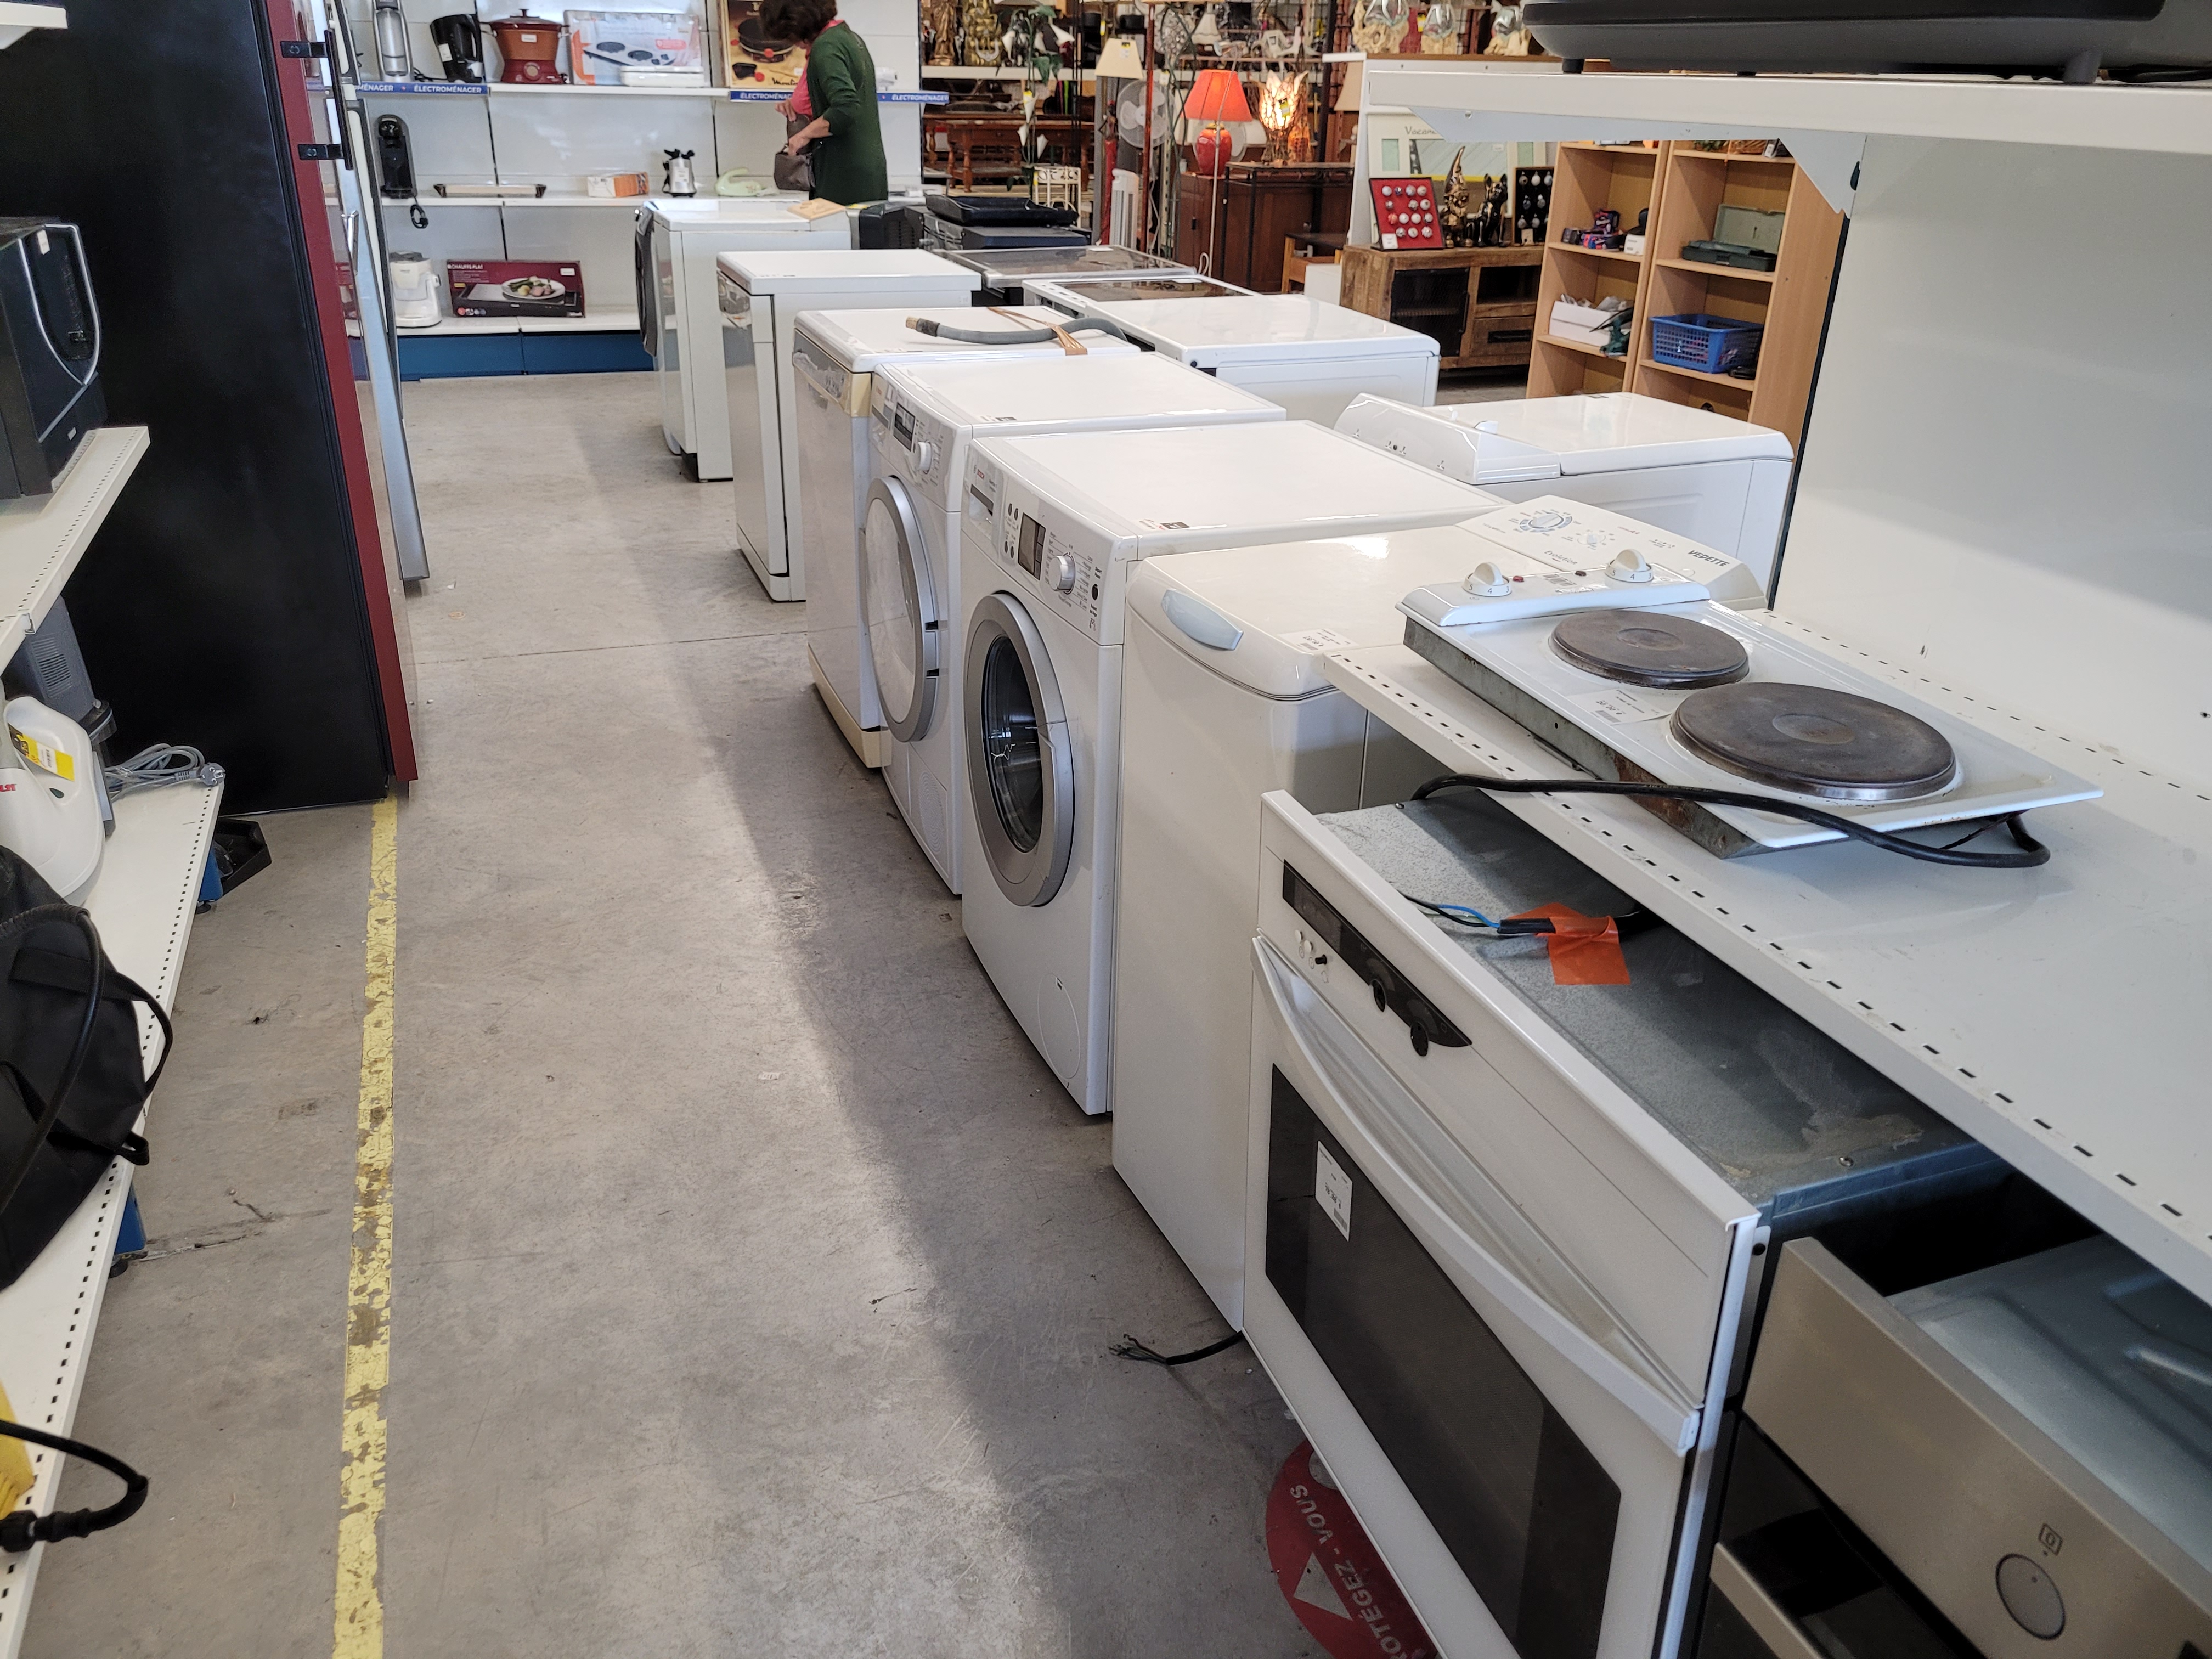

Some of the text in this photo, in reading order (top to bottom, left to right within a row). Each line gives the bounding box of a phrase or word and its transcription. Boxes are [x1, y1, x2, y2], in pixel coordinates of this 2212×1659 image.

[414, 83, 482, 93] ÉLECTROMÉNAGER
[1544, 550, 1578, 566] Evolution
[1687, 550, 1730, 567] VEDETTE
[1289, 1485, 1333, 1544] VOUS
